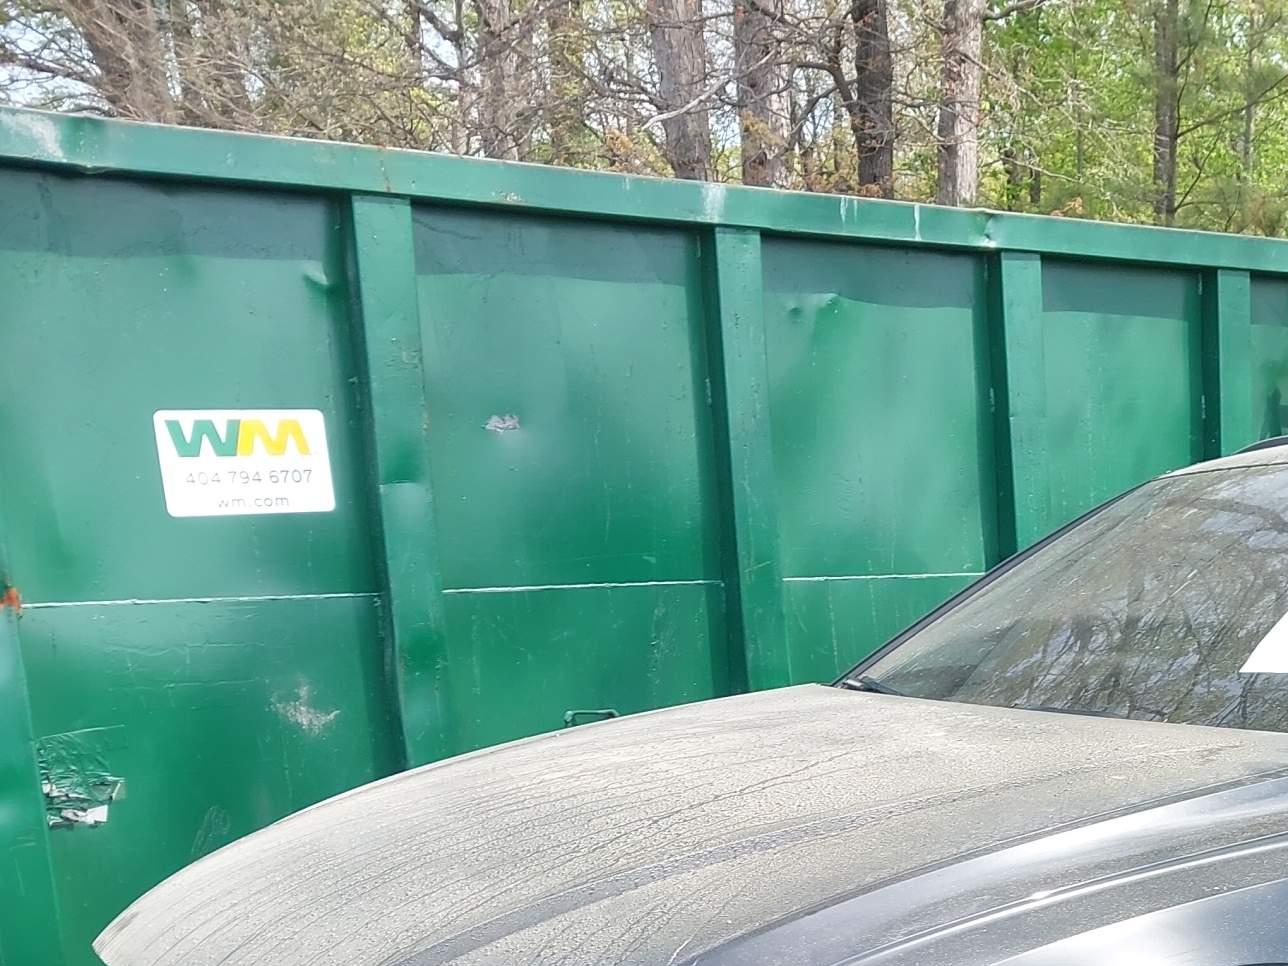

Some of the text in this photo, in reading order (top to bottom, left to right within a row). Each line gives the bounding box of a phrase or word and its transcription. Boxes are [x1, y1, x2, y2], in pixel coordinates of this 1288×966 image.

[164, 418, 311, 458] WM
[185, 468, 313, 485] 404 794 6707
